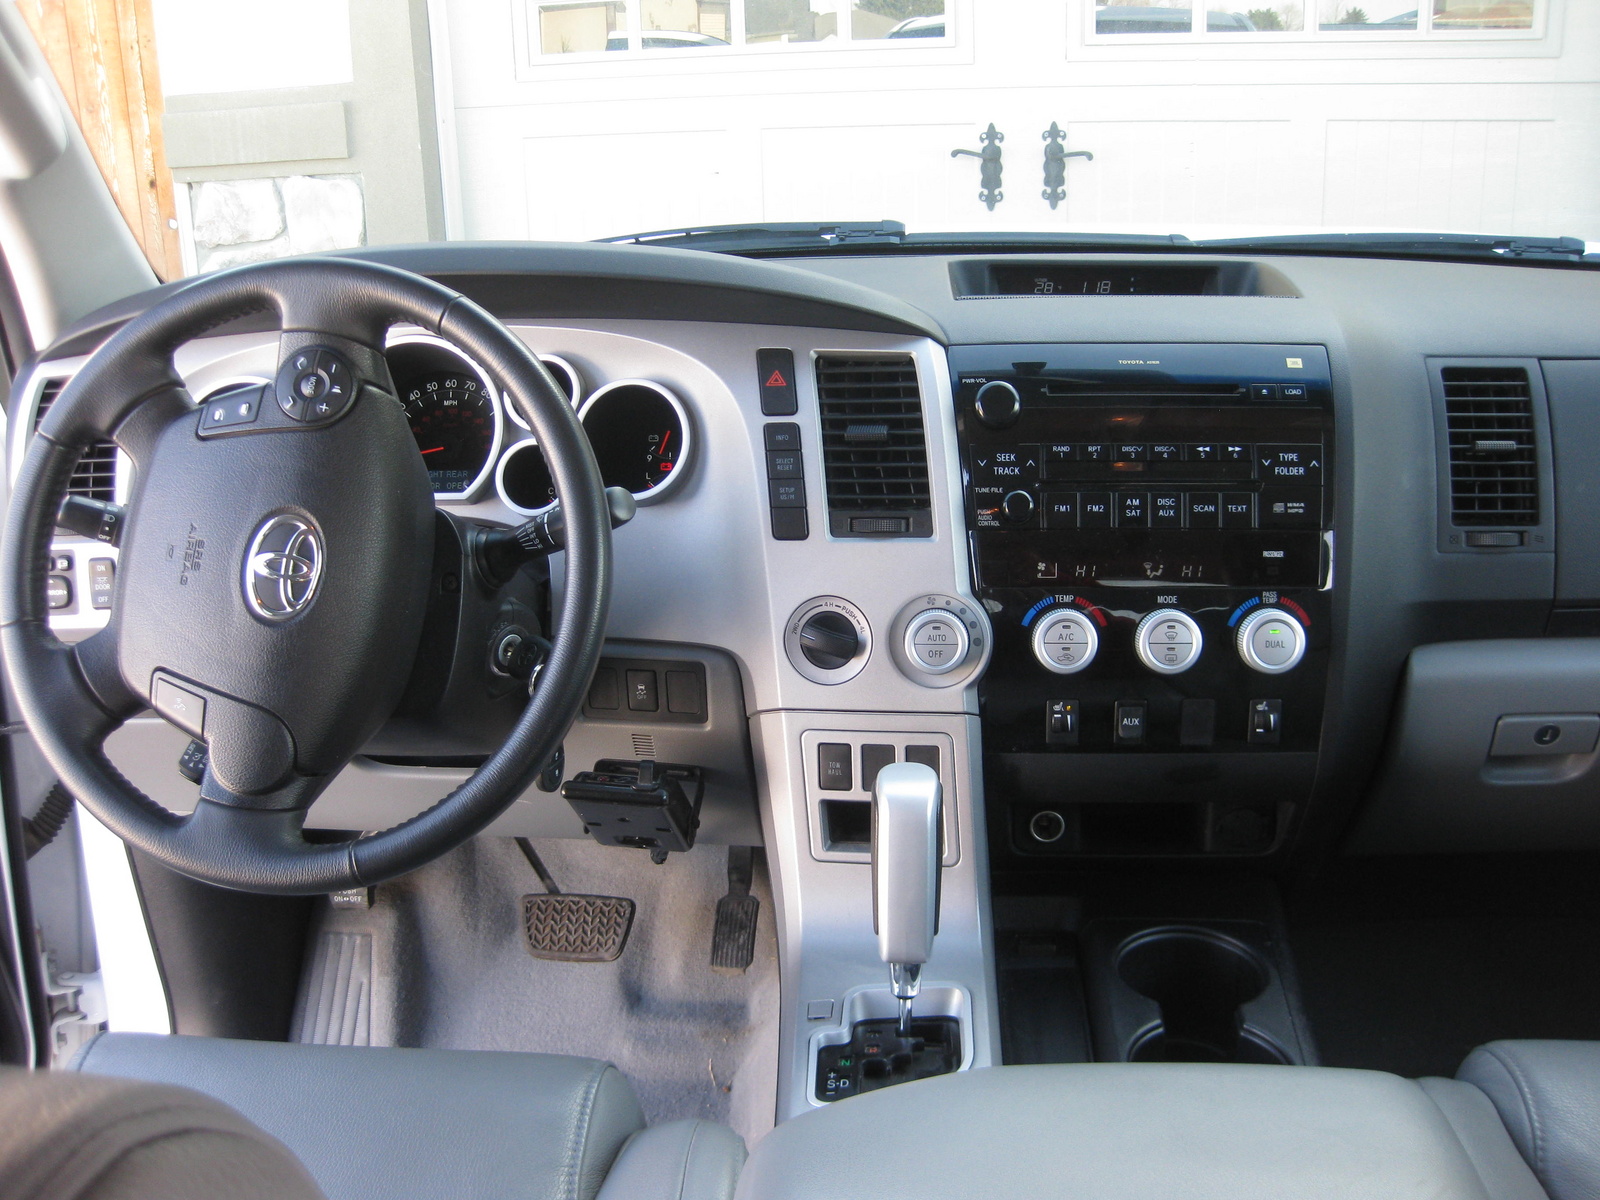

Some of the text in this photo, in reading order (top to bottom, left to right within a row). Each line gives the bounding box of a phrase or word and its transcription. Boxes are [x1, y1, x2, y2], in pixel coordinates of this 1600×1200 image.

[1034, 281, 1054, 294] 28
[306, 376, 317, 395] MODE
[426, 381, 438, 392] 50
[445, 379, 457, 388] 60
[464, 380, 476, 391] 70
[409, 389, 421, 401] 40
[481, 387, 491, 399] 80
[646, 454, 653, 463] 9
[996, 453, 1016, 462] SEEK
[1279, 453, 1299, 462] TYPE
[446, 470, 468, 478] REAR
[993, 466, 1020, 475] TRACK
[1274, 466, 1305, 476] FOLDER
[645, 472, 651, 480] L
[547, 486, 554, 495] C
[1125, 498, 1140, 506] AM
[1157, 498, 1176, 506] DISC
[1193, 504, 1215, 512] SCAN
[1227, 504, 1247, 512] TEXT
[1125, 509, 1141, 517] SAT
[1158, 509, 1175, 517] AUX
[1054, 594, 1075, 603] TEMP
[1156, 595, 1178, 604] MODE
[841, 605, 858, 620] PUSH
[927, 634, 947, 642] AUTO
[1057, 632, 1075, 642] A/C
[1265, 640, 1286, 648] DUAL
[928, 650, 943, 659] OFF
[1122, 717, 1139, 726] AUX
[827, 768, 842, 776] HAUL
[840, 1058, 851, 1066] N
